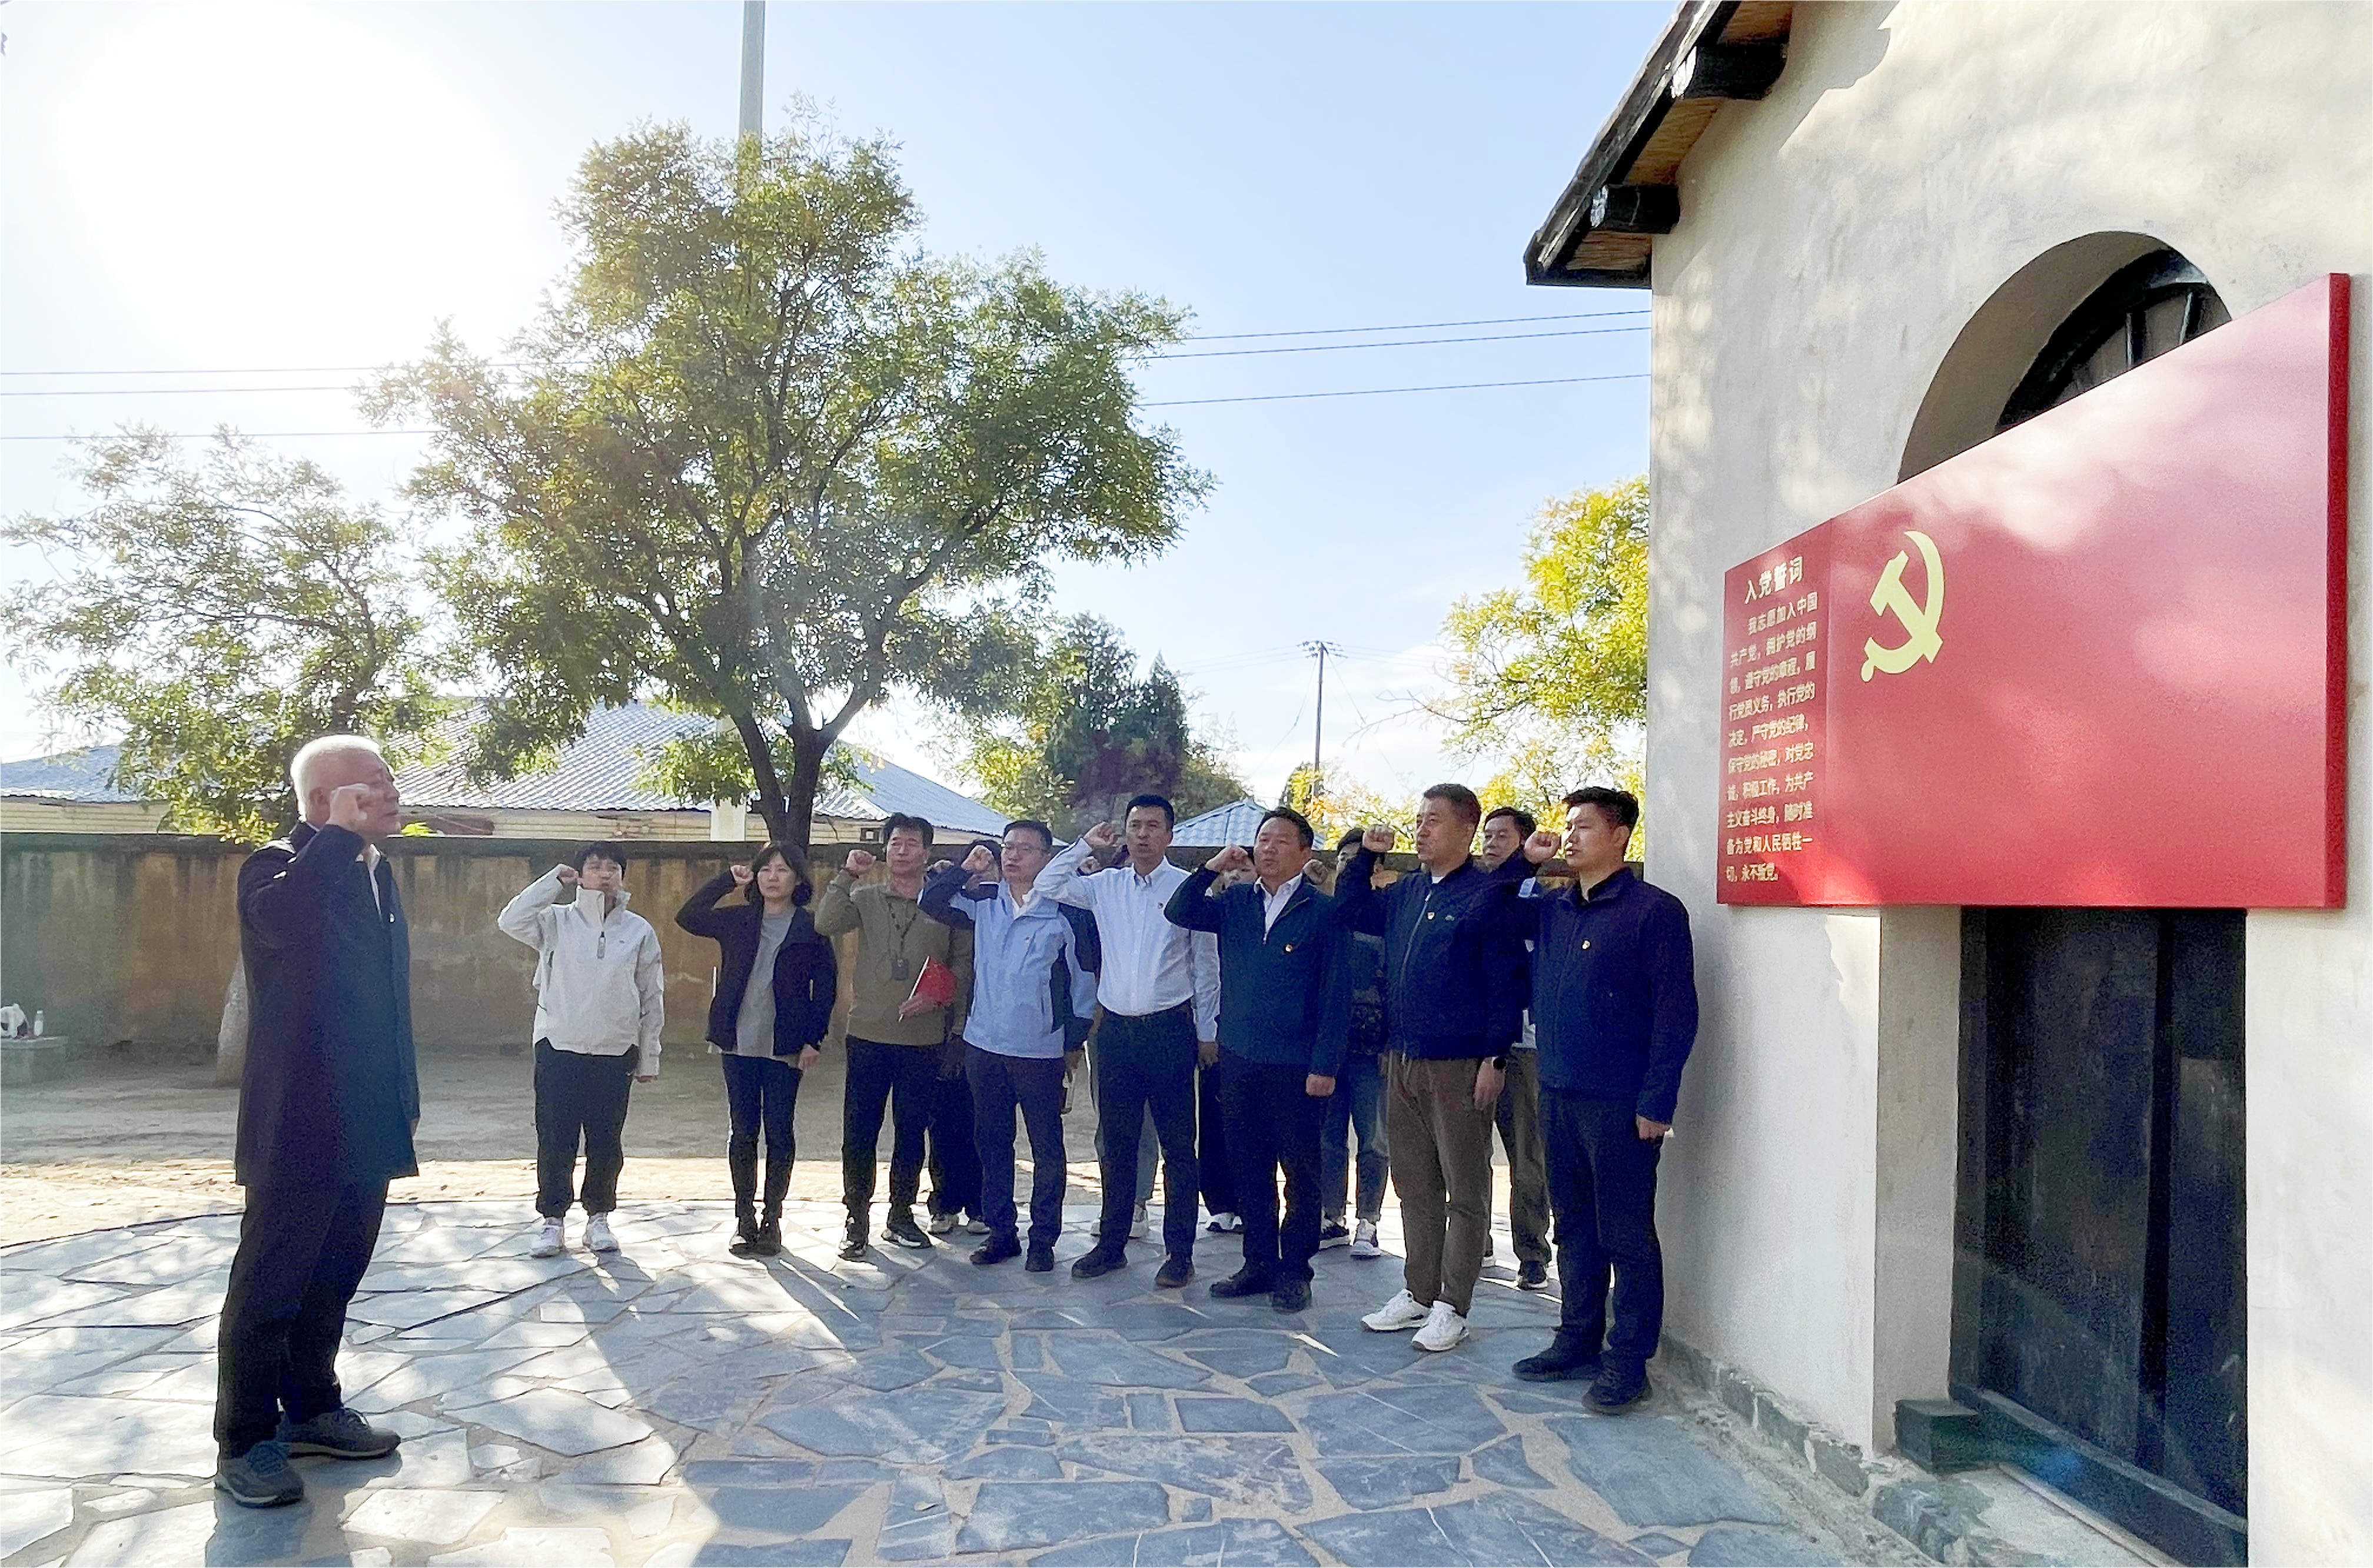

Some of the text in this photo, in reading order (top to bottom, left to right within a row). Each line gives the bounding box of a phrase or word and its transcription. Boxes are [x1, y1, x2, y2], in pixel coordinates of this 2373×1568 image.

[1744, 556, 1803, 604] 入党誓词
[1748, 592, 1817, 636] 我志愿加入中国
[1726, 831, 1813, 855] 备为党和人民牺牲一
